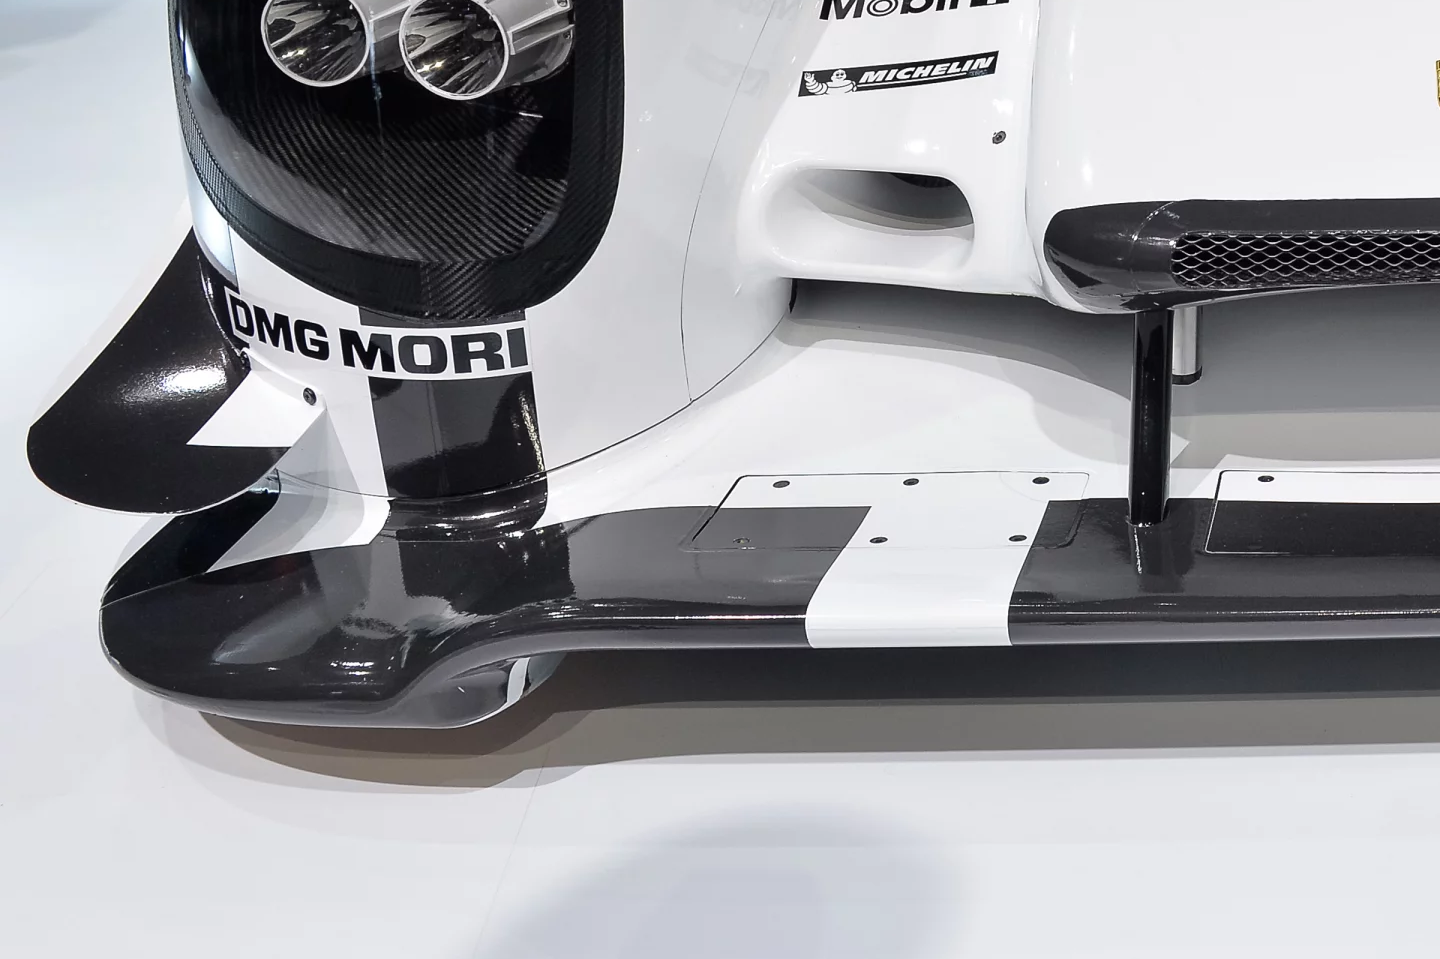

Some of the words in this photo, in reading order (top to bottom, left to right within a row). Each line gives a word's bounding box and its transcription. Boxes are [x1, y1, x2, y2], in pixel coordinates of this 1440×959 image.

[858, 55, 995, 84] MICHELIN
[229, 294, 330, 362] DMG
[338, 326, 529, 375] MORI
